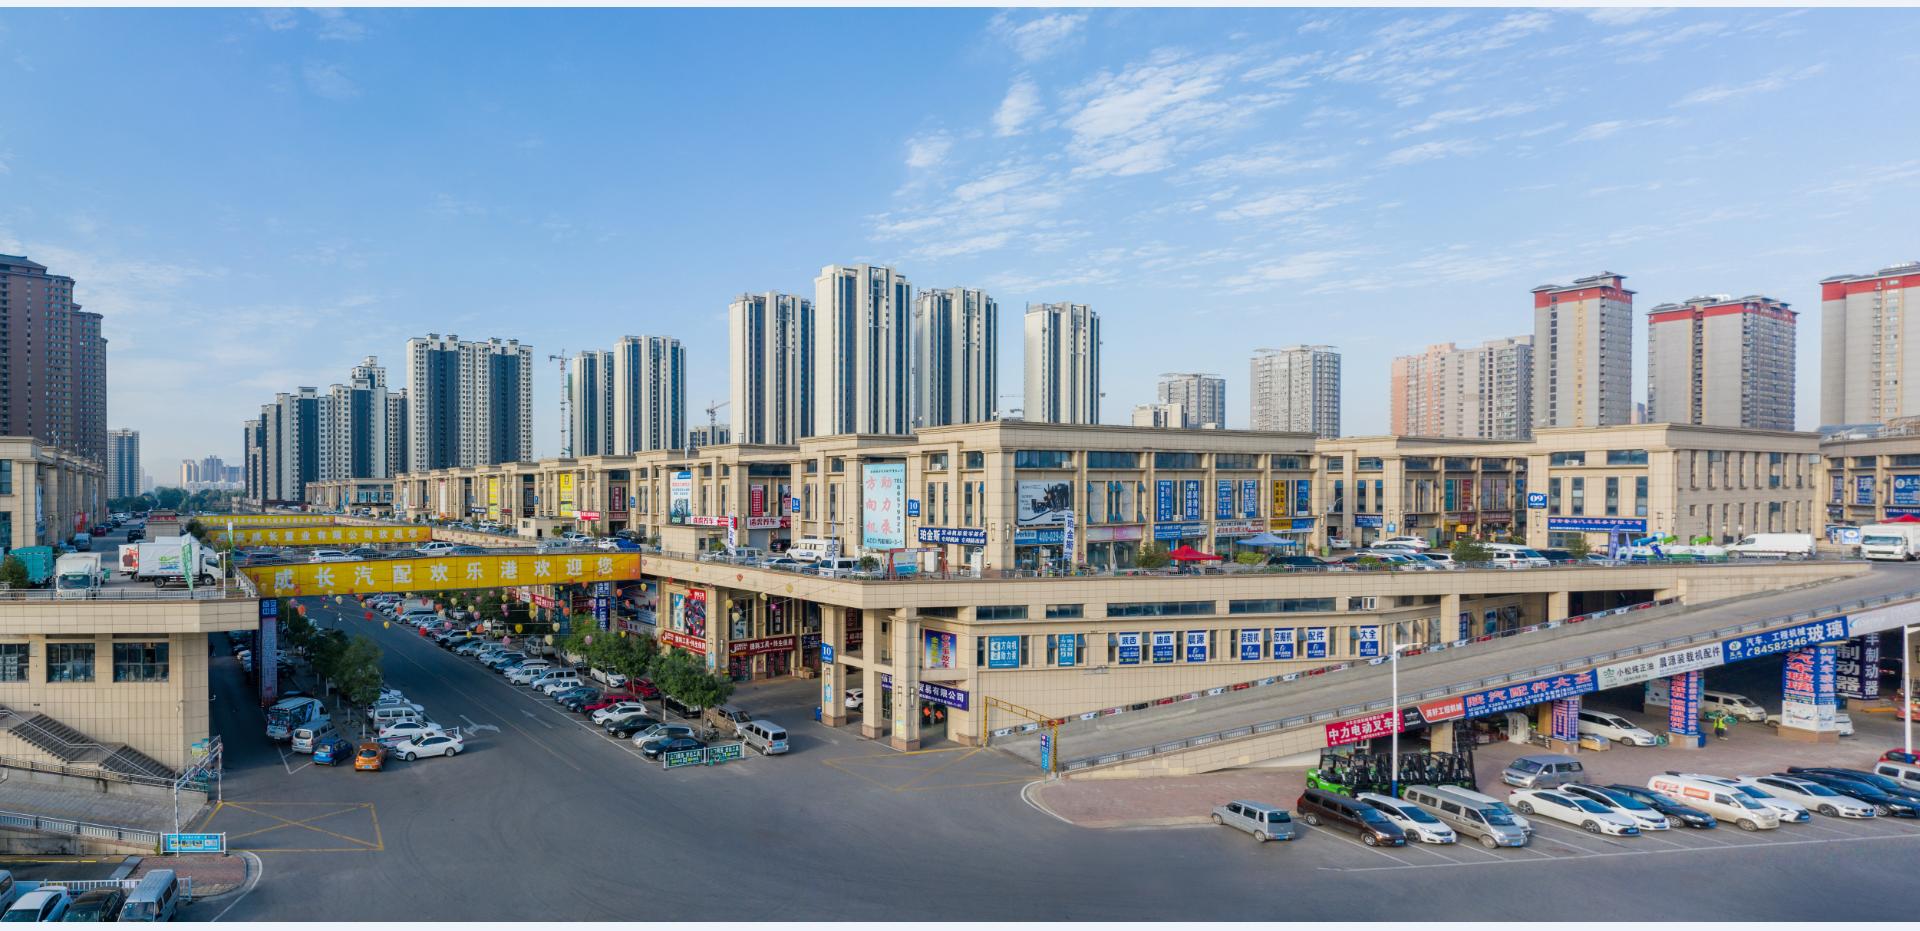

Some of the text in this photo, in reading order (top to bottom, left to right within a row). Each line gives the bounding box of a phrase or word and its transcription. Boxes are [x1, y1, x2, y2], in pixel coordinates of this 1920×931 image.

[1529, 494, 1543, 502] 09
[909, 501, 918, 510] 10
[274, 557, 614, 590] 成长汽配欢乐港欢迎您
[1241, 631, 1260, 642] 装载机
[1274, 631, 1293, 642] 挖掘机
[1307, 631, 1325, 641] 配件
[1360, 629, 1377, 640] 大全
[1807, 620, 1844, 642] 玻璃
[1001, 640, 1017, 650] 方向机
[1754, 637, 1808, 655] 84582346
[823, 646, 832, 656] 10
[1659, 647, 1721, 669] 晨源装载机配件
[1837, 643, 1861, 692] 制动器
[1466, 674, 1592, 708] 陕汽配件大全
[1328, 718, 1394, 741] 中力电动叉车
